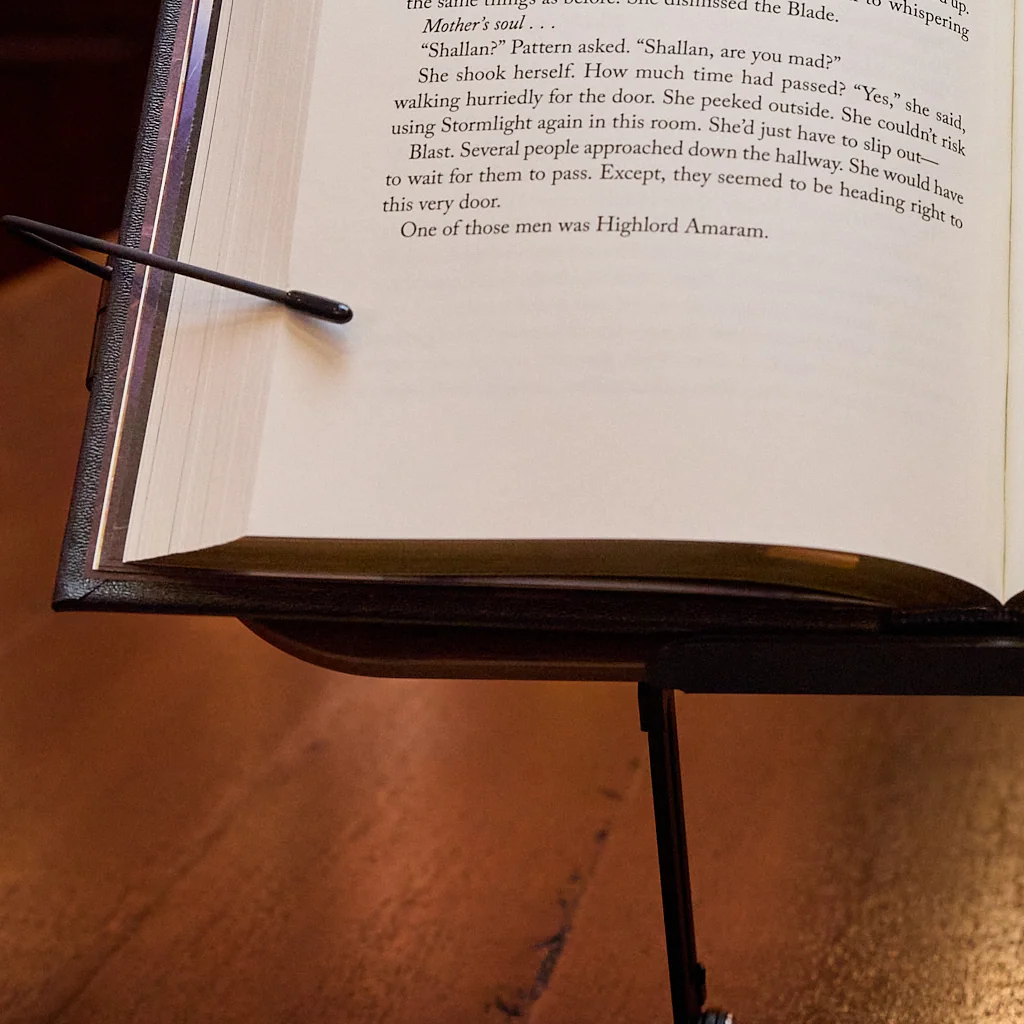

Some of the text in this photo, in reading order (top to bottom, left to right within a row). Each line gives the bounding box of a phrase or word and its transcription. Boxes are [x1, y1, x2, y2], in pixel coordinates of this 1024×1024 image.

[787, 0, 839, 23] Blade.
[421, 37, 842, 70] “Shallan?” Pattern asked. “Shallan, are you mad?”
[400, 215, 769, 239] One of those men was Highlord Amaram.
